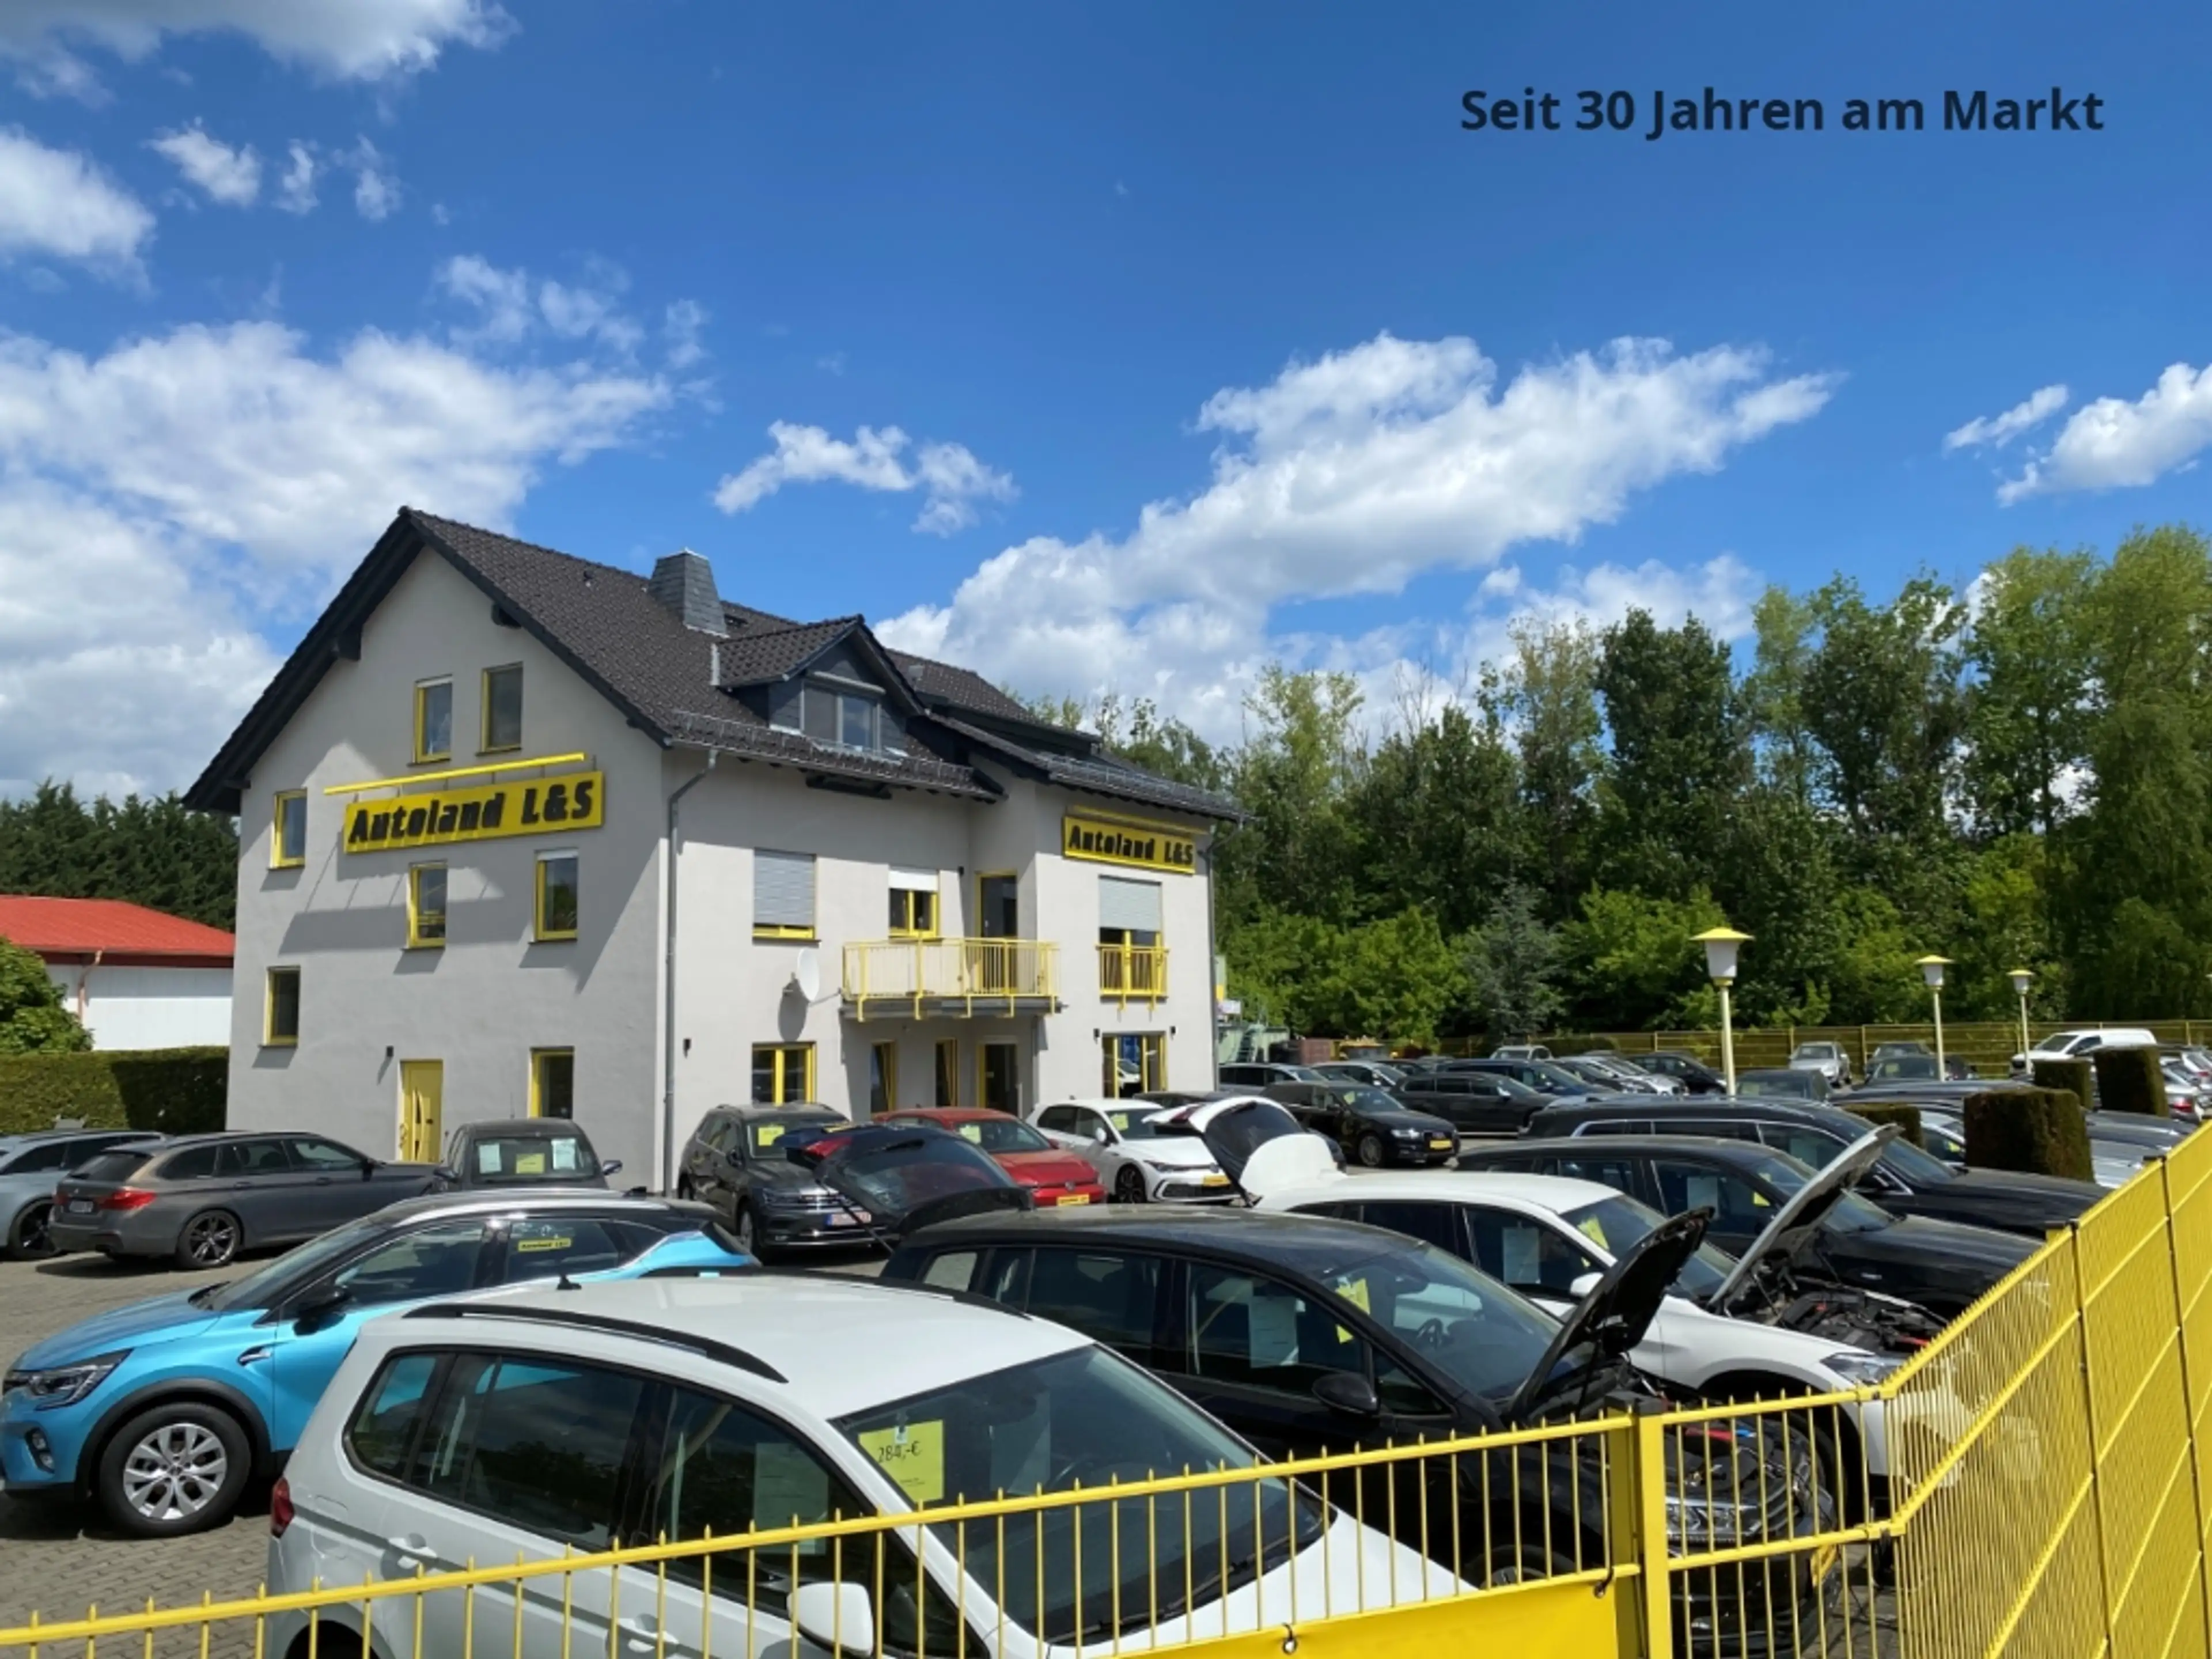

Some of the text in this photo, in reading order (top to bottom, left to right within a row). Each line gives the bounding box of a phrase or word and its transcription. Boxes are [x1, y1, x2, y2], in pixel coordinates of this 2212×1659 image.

[347, 781, 593, 844] Autoland L&S
[1069, 825, 1194, 865] Autoland L&S
